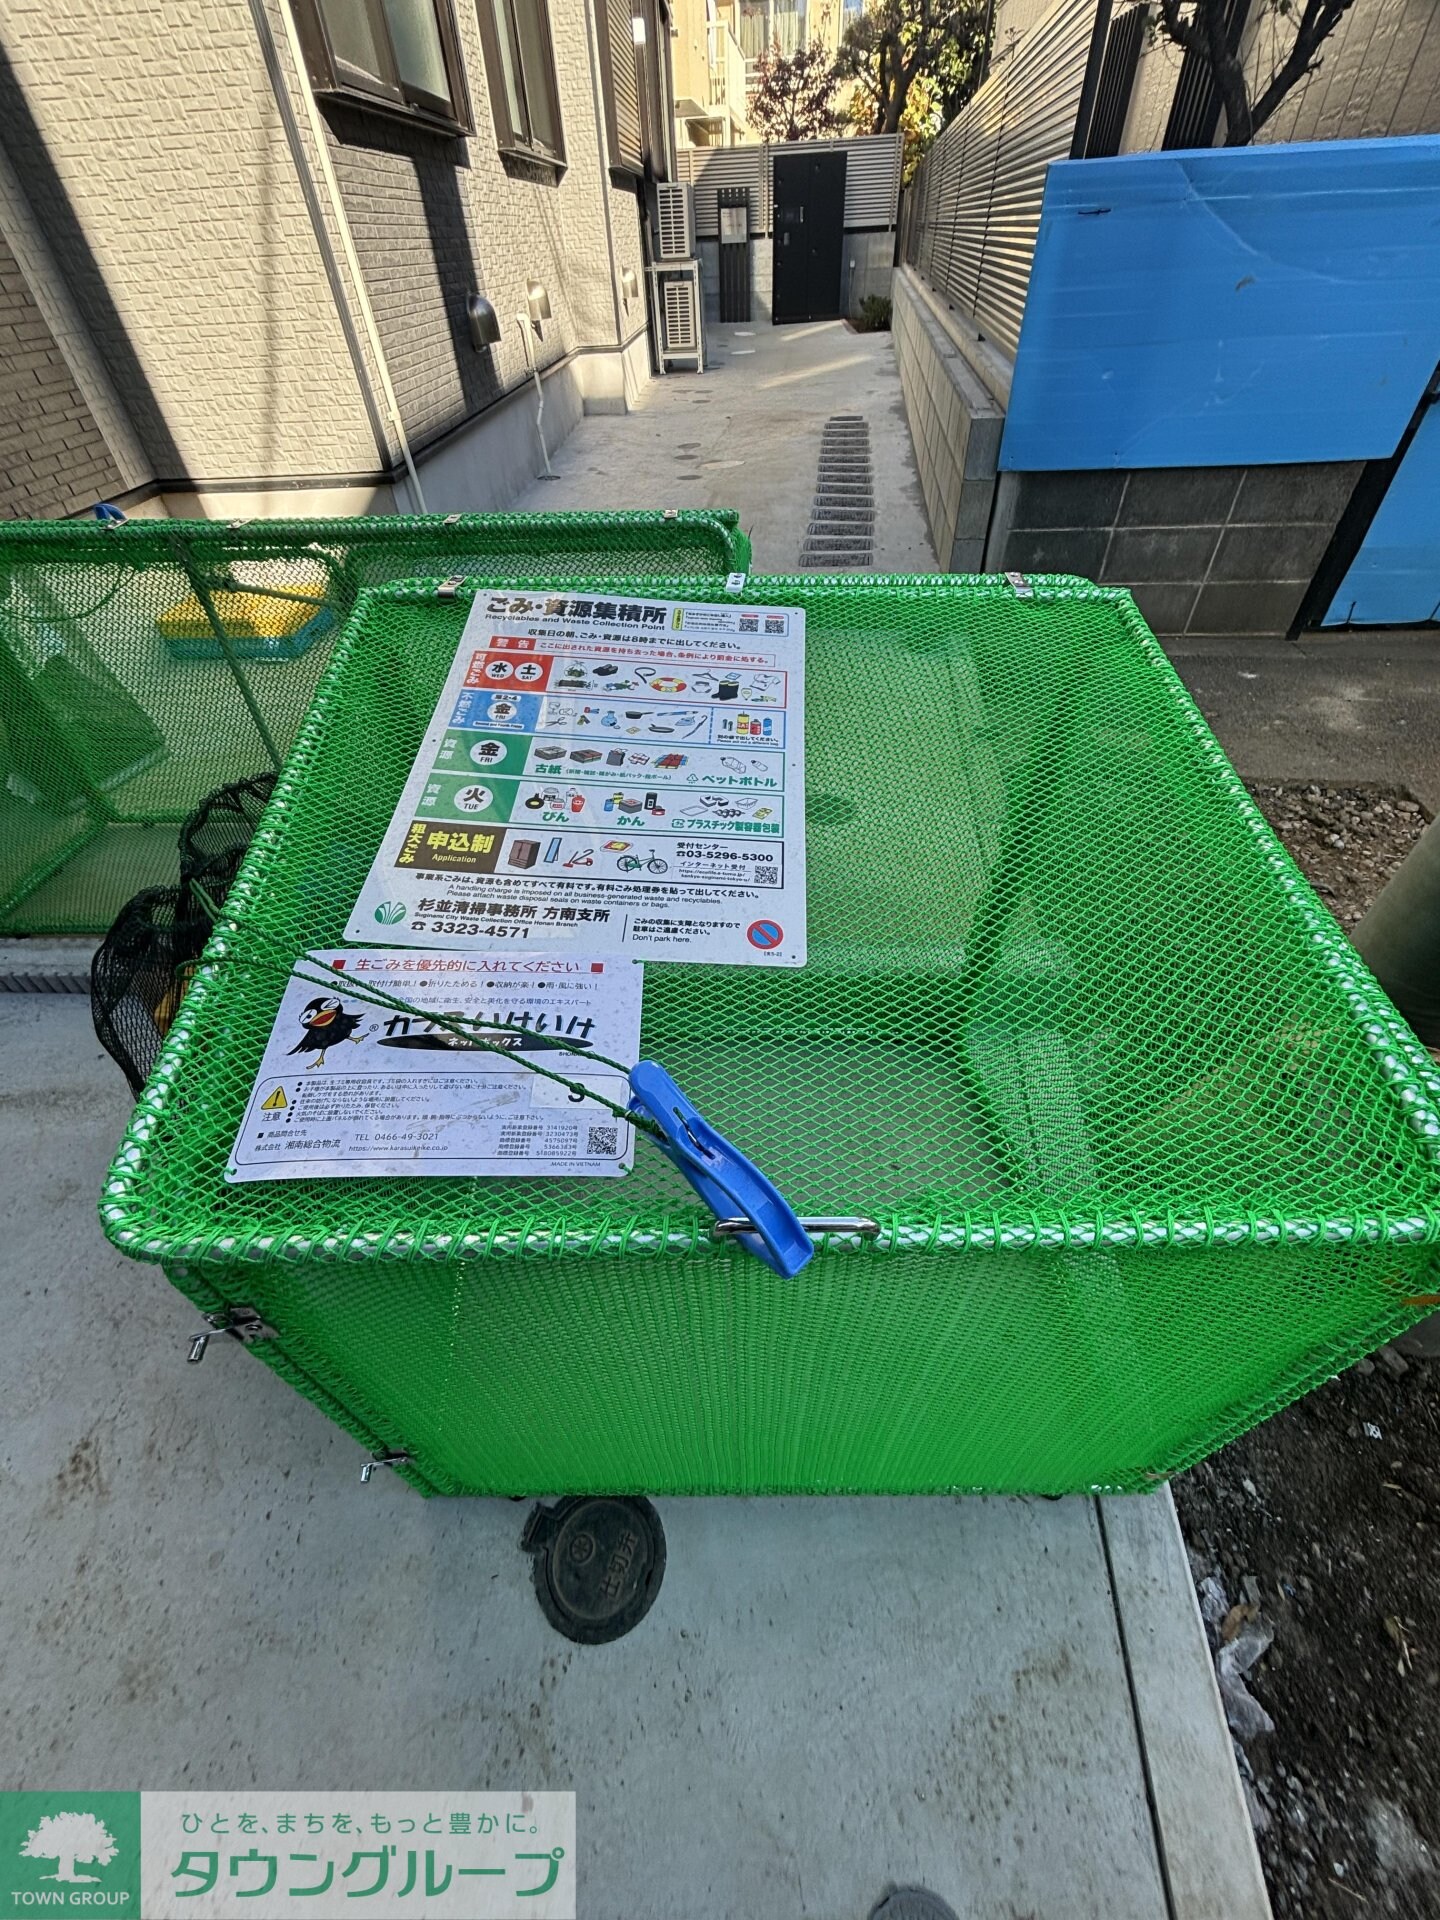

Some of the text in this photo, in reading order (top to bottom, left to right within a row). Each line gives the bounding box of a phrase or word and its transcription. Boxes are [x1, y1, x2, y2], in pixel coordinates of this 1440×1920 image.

[486, 597, 668, 625] ごみ・資源集積所
[485, 613, 540, 623] Recyclables
[562, 617, 591, 626] Waste
[592, 619, 641, 628] Collection
[642, 622, 666, 631] Point
[491, 662, 508, 673] 水
[520, 664, 536, 675] 土
[493, 703, 512, 714] 金
[439, 738, 458, 760] 資源
[478, 742, 501, 757] 金
[535, 763, 562, 775] 古紙
[702, 775, 778, 788] ペットボトル
[421, 783, 442, 806] 資源
[463, 787, 486, 803] 火
[542, 811, 570, 823] びん
[616, 815, 645, 828] かん
[687, 818, 780, 834] プラスチック製容器包装
[398, 822, 428, 864] 粗大ごみ
[426, 831, 495, 854] 申込制
[676, 842, 729, 851] 受付センター
[431, 853, 477, 864] Application
[686, 850, 774, 862] 03-5296-5300
[680, 861, 746, 871] インターネット受付
[446, 889, 472, 898] Please
[472, 891, 495, 899] attach
[496, 893, 518, 901] waste
[518, 894, 549, 903] disposal
[603, 898, 640, 907] containers
[650, 901, 670, 909] bags.
[456, 885, 486, 893] handling
[487, 887, 513, 895] charge
[521, 888, 552, 897] imposed
[574, 891, 643, 901] business-generated
[644, 894, 665, 902] waste
[417, 897, 611, 923] 杉並清掃事務所 方南支所
[414, 912, 445, 920] Suginami
[446, 913, 459, 921] City
[480, 916, 513, 924] Collection
[633, 917, 741, 929] ごみの収集に支障となりますので
[431, 921, 530, 939] 3323-4571
[632, 925, 711, 936] 駐車はご遠慮ください。
[632, 934, 653, 942] Don't
[653, 935, 671, 943] park
[354, 958, 580, 973] 生ごみを優先的に入れてください
[568, 1082, 586, 1103] S
[261, 1111, 282, 1122] 注意
[266, 1129, 308, 1139] 商品問合せ先
[354, 1132, 439, 1142] TEL 0466-49-3021
[284, 1139, 342, 1151] 湘南総合物流
